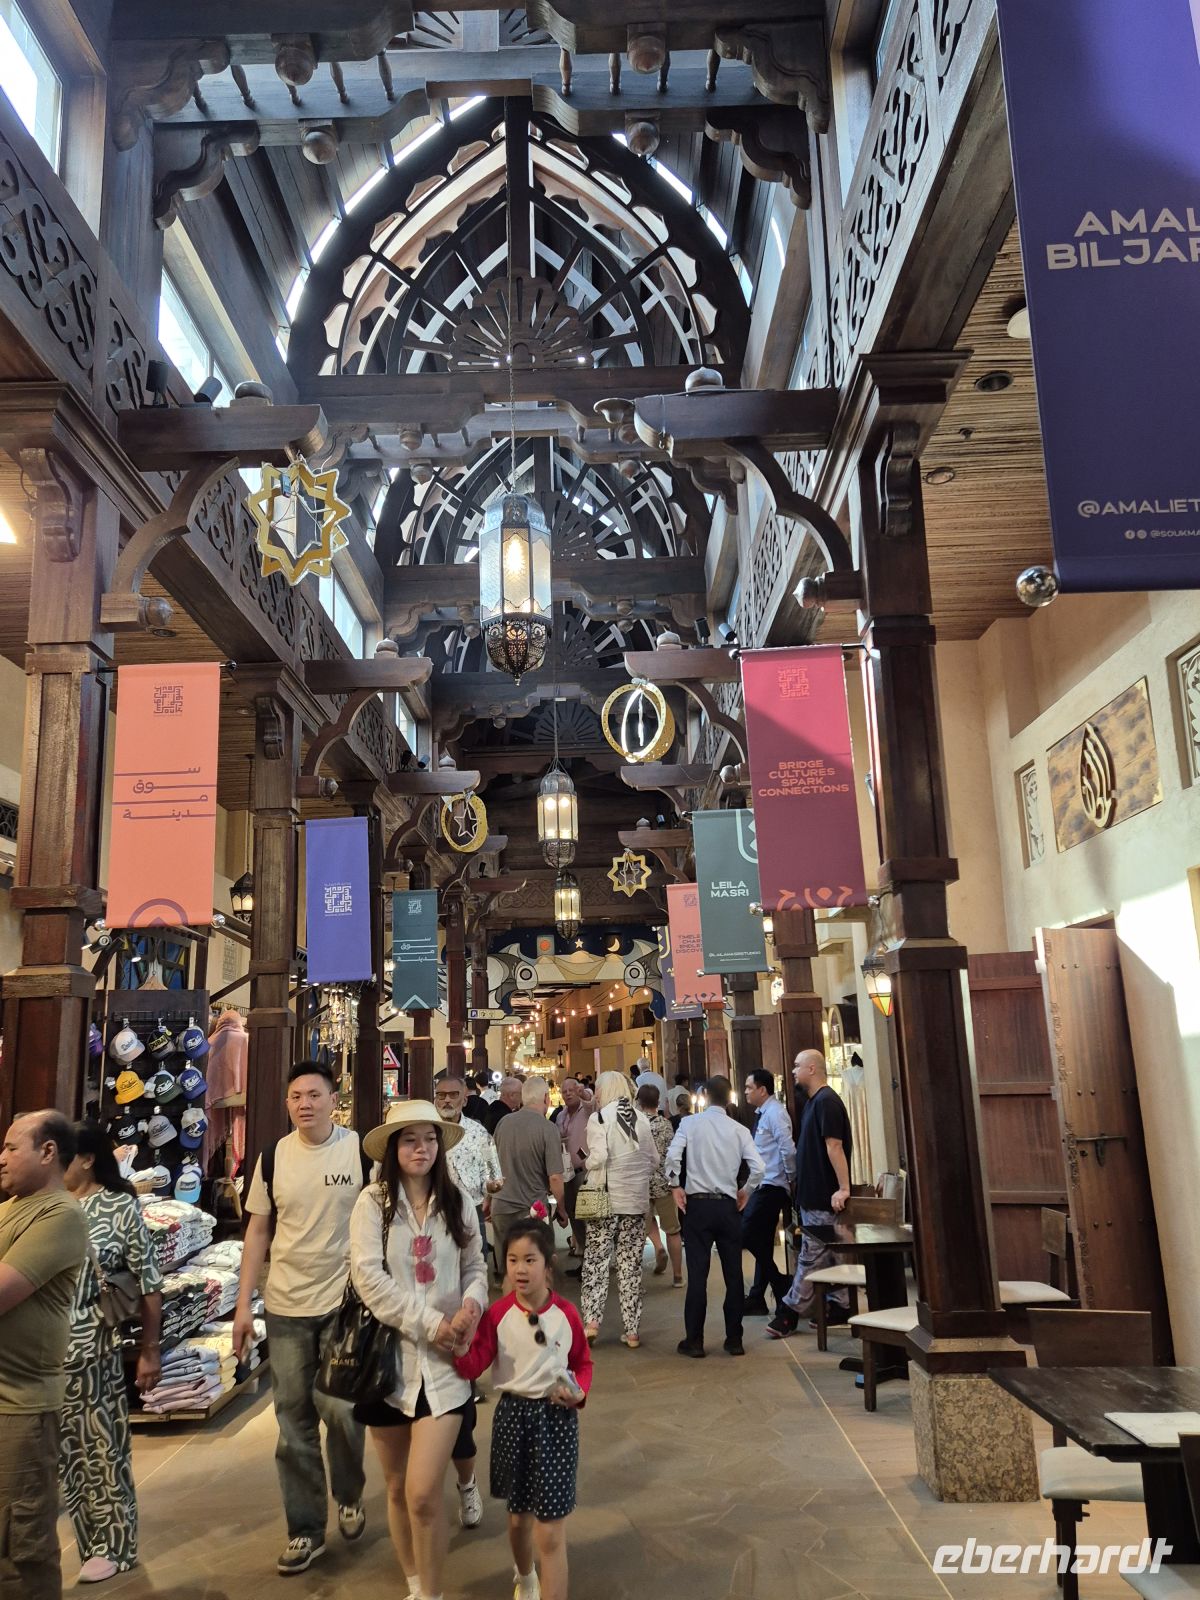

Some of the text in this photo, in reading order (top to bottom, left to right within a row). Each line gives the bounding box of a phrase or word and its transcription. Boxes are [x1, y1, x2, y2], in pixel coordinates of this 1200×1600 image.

[778, 759, 824, 770] BRIDGE
[768, 767, 836, 779] CULTURES
[780, 777, 824, 787] SPARK
[758, 784, 849, 797] CONNECTIONS
[711, 880, 747, 890] LEILA
[710, 888, 749, 898] MASRI
[325, 1173, 354, 1186] L.V.M.
